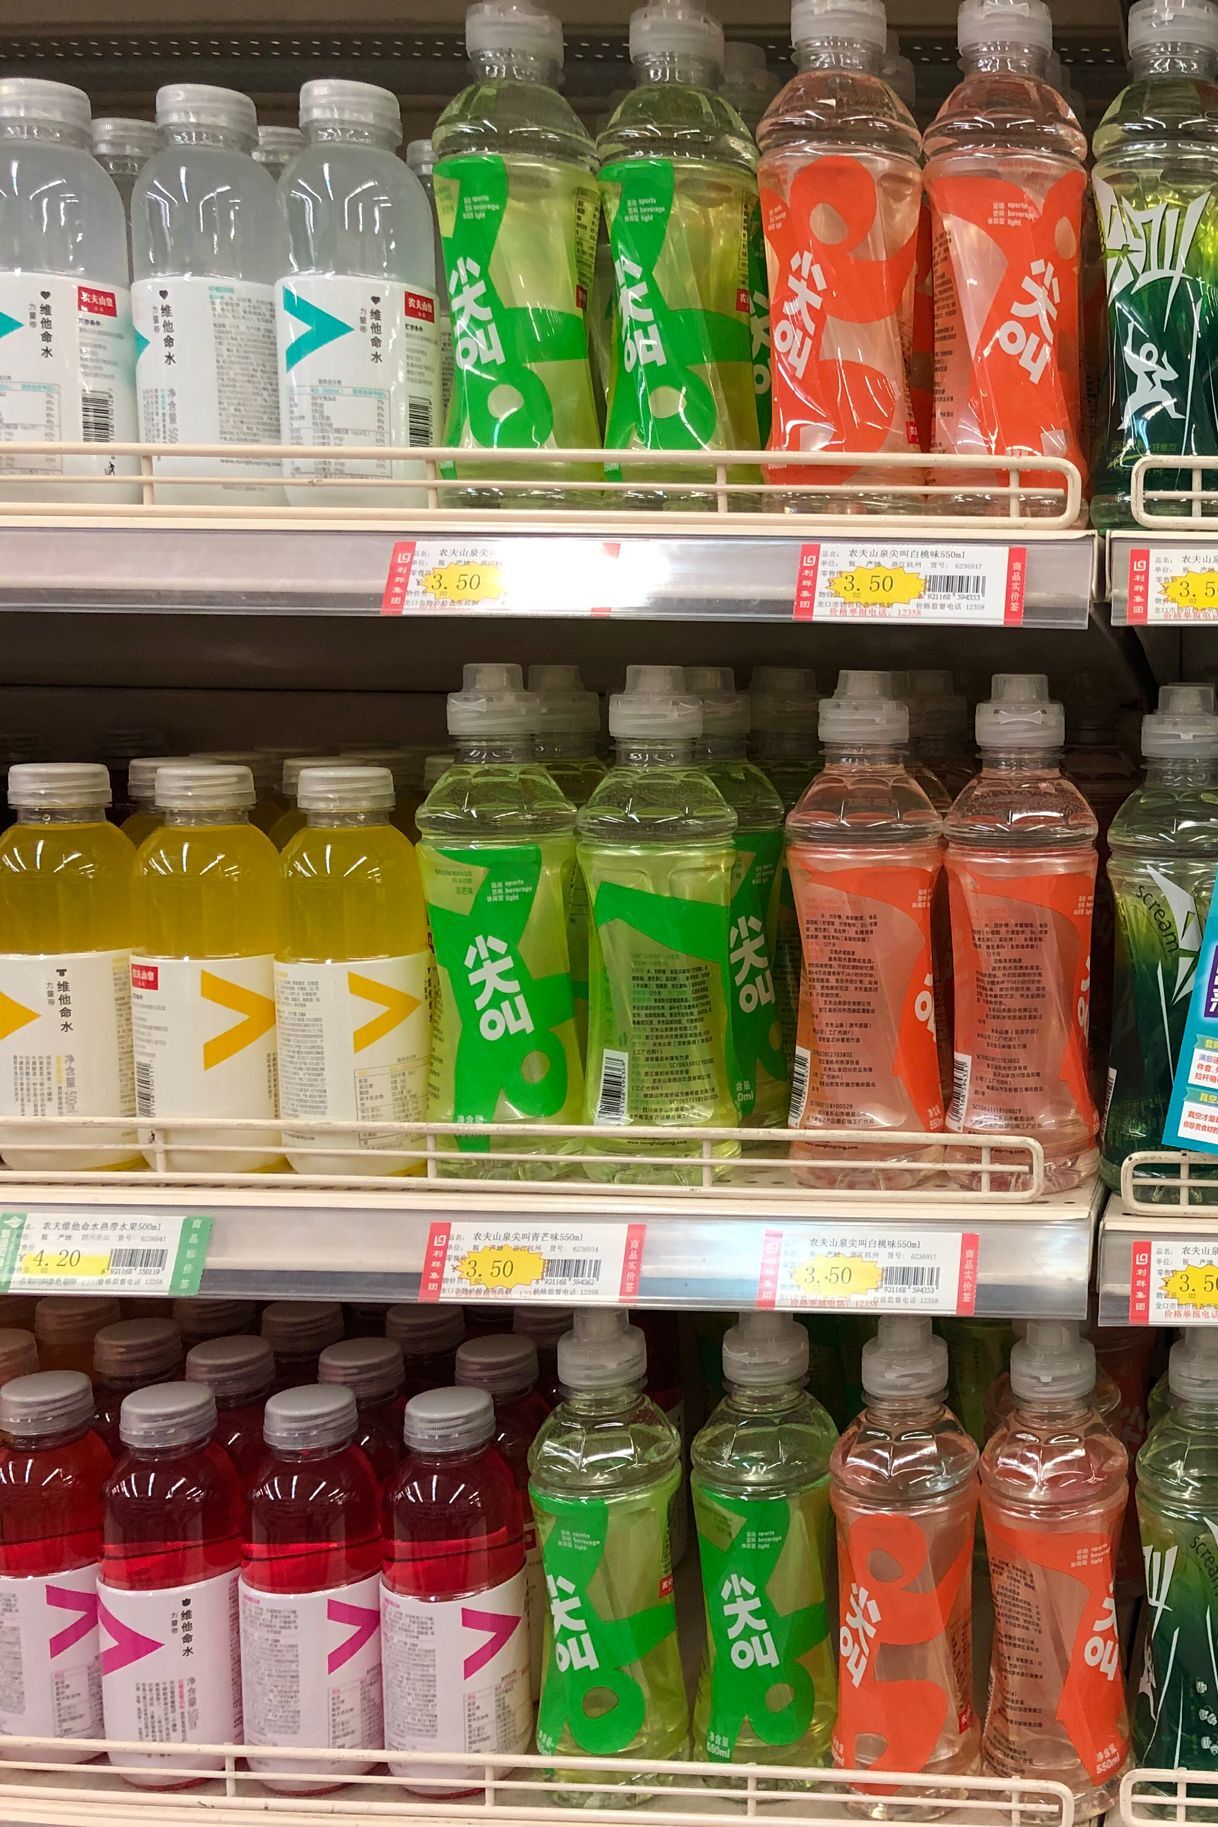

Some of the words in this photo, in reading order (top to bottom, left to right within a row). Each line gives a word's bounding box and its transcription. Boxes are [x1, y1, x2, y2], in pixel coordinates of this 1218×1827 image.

[40, 304, 54, 359] 维他命水
[161, 304, 176, 366] 维他命水
[370, 308, 383, 364] 维他命水
[999, 258, 1061, 384] 尖叫
[431, 573, 481, 591] 3.50
[843, 574, 894, 593] 3.50
[56, 980, 74, 1034] 维他命水
[464, 934, 535, 1041] 尖叫
[33, 1249, 81, 1268] 4.20
[466, 1260, 514, 1278] 3.50
[181, 1609, 195, 1657] 维他命水
[720, 1573, 780, 1670] 尖叫
